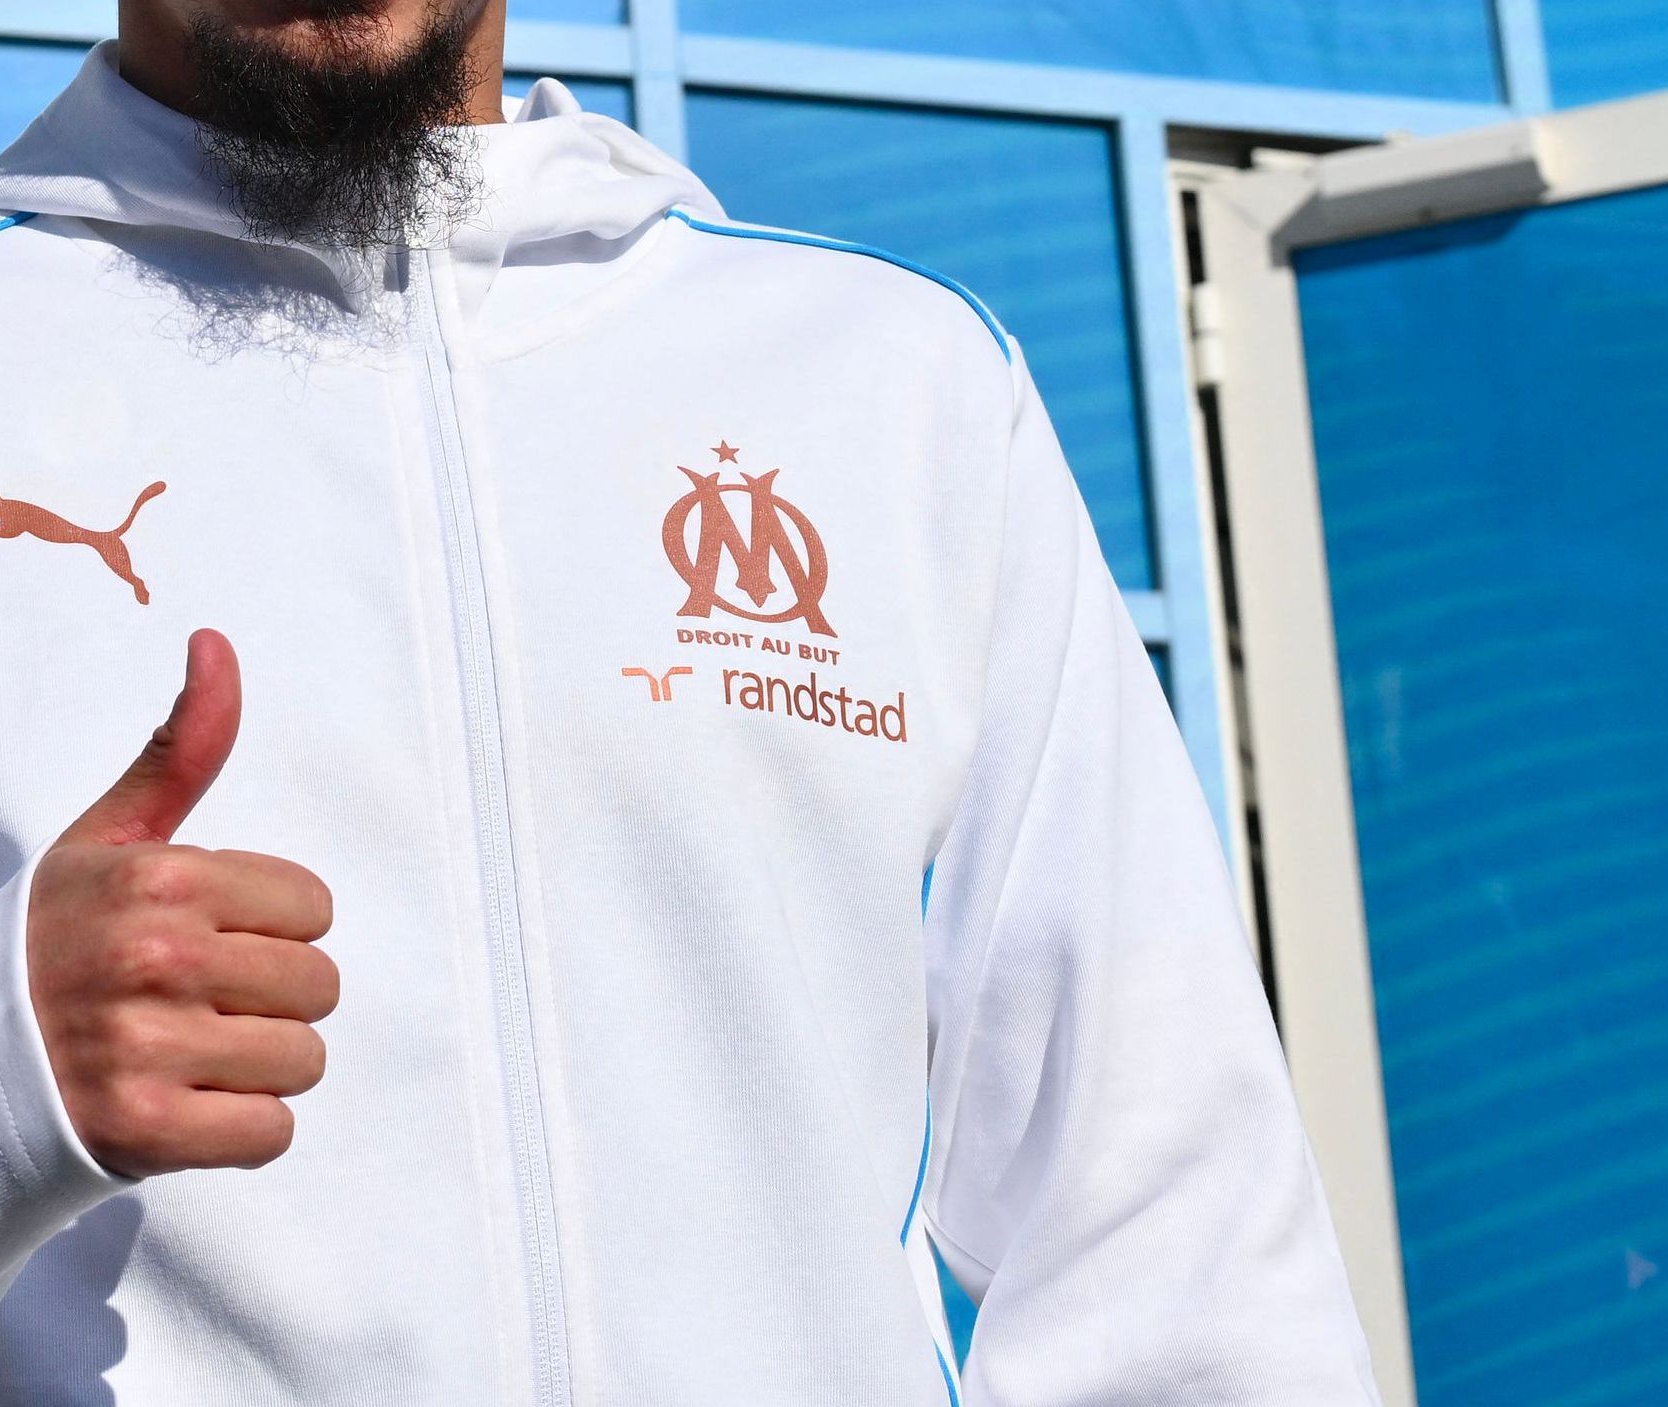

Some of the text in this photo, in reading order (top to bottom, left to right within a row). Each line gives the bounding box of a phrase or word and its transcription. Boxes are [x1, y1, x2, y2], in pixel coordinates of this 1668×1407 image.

[676, 628, 841, 666] DROIT AU BUT
[722, 668, 908, 743] randstad
